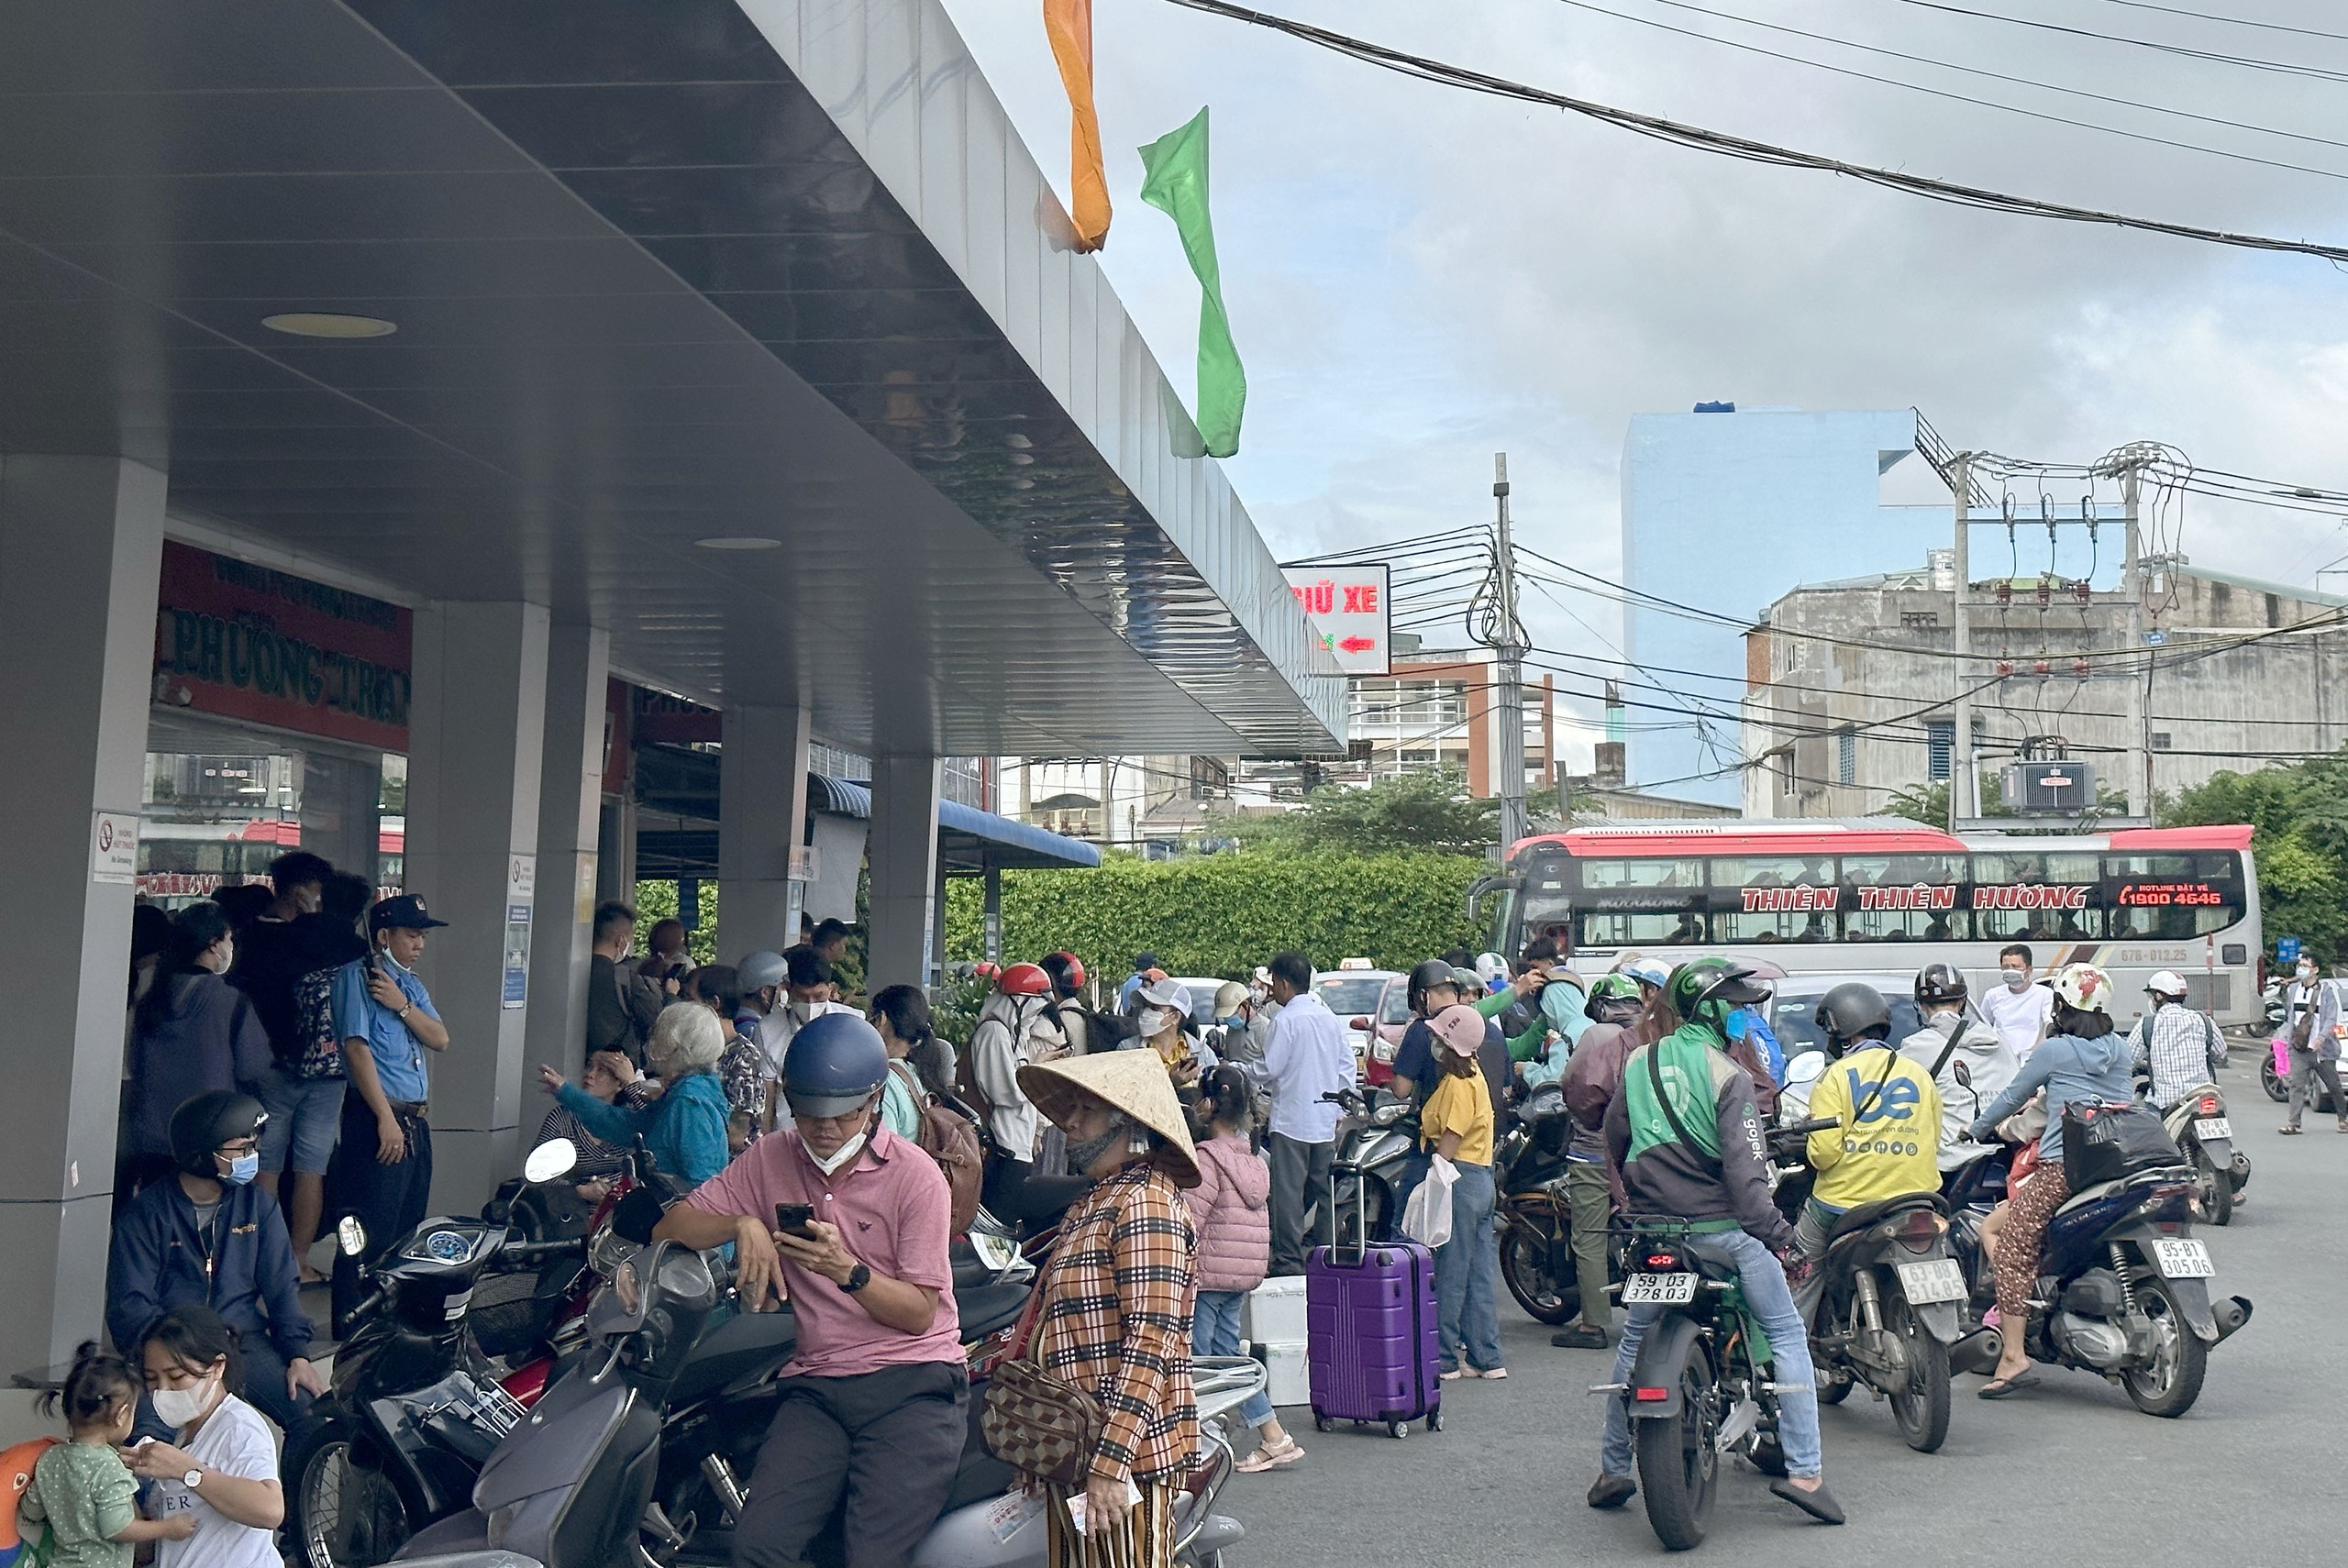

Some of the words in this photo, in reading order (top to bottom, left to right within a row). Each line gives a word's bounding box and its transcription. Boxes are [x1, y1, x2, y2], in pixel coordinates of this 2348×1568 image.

[1342, 584, 1378, 613] XE
[1741, 882, 1839, 911] THIÊN
[1857, 881, 1956, 911] THIÊN
[1973, 882, 2092, 910] HƯƠNG
[2129, 892, 2171, 905] 1900
[2174, 892, 2221, 905] 4646
[2139, 884, 2176, 892] HOTLINE
[1846, 1067, 1920, 1123] be
[1744, 1119, 1763, 1161] gojek
